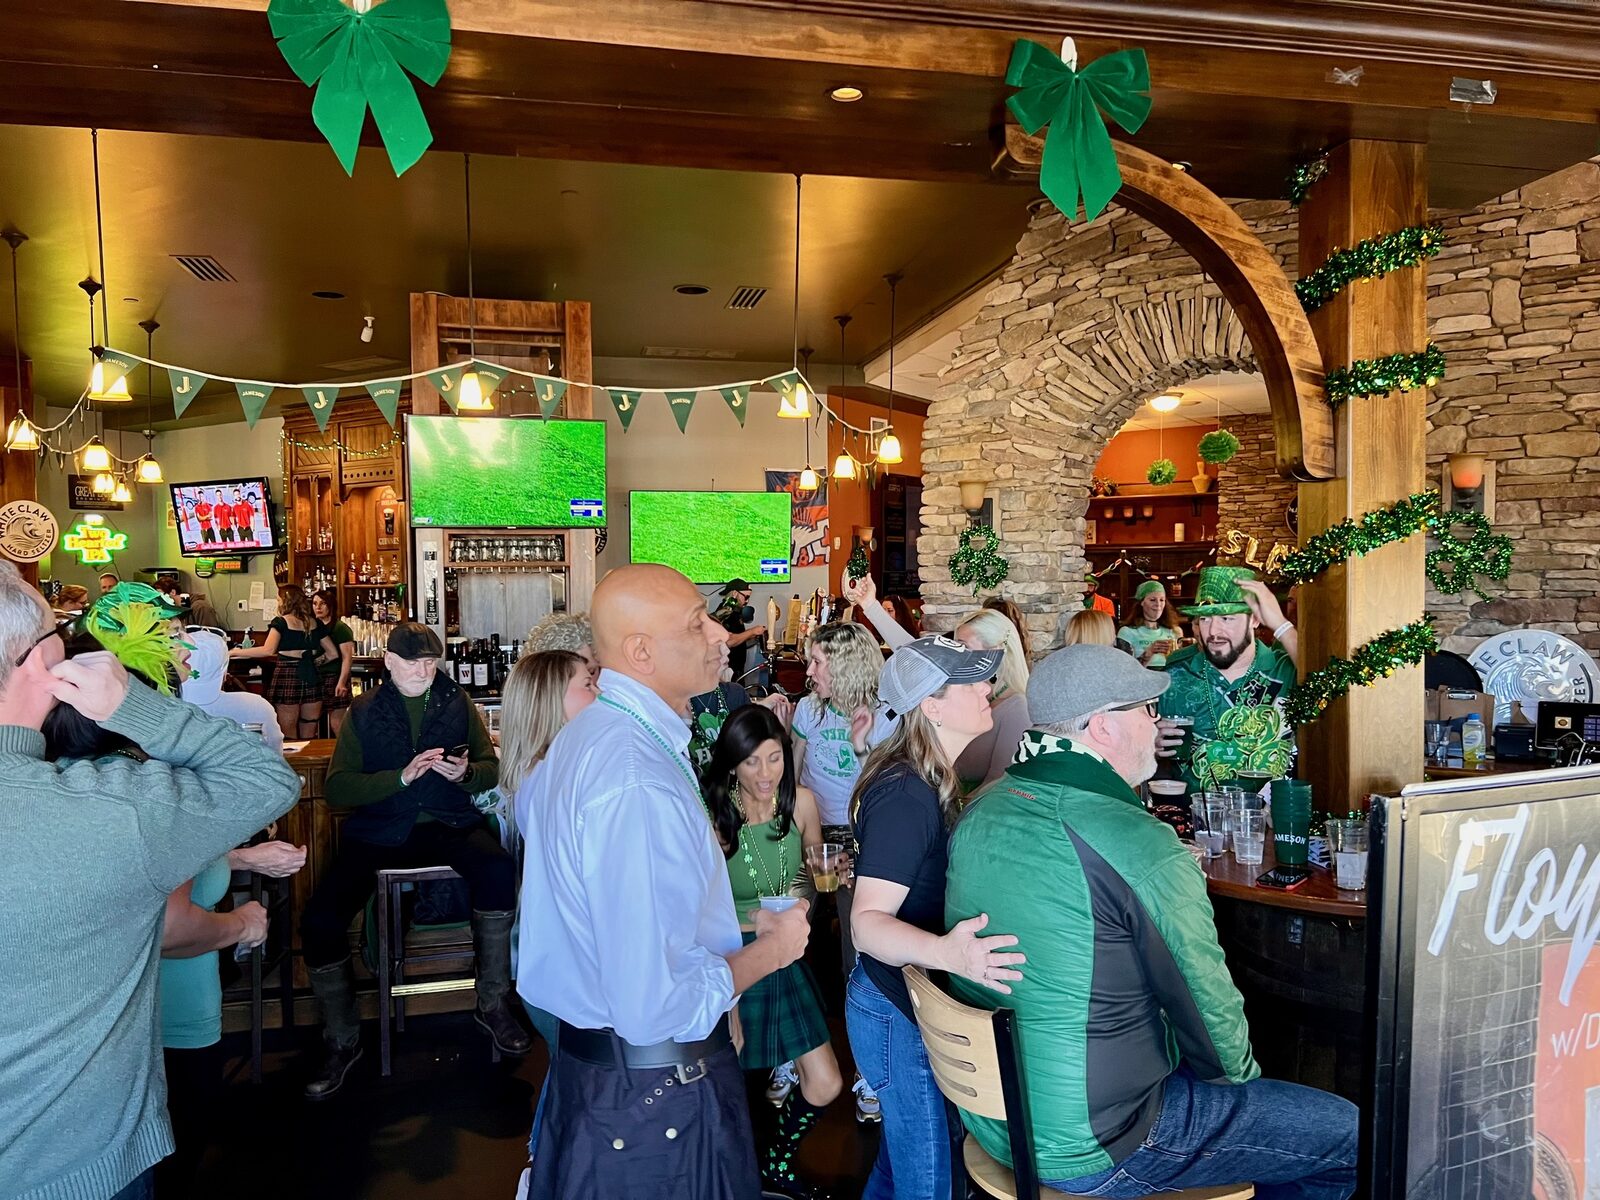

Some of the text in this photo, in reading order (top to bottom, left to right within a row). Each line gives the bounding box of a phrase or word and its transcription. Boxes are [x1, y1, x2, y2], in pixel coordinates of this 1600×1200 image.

[105, 358, 128, 369] JAMESON
[479, 370, 500, 380] JAMESON
[242, 390, 265, 398] JAMESON
[374, 388, 395, 397] JAMESON
[17, 504, 50, 522] CLAW
[79, 526, 107, 538] Two
[6, 529, 52, 556] HARD SELTZER
[67, 536, 124, 549] Hearted
[86, 549, 106, 560] IPA
[1499, 638, 1575, 665] CLAW
